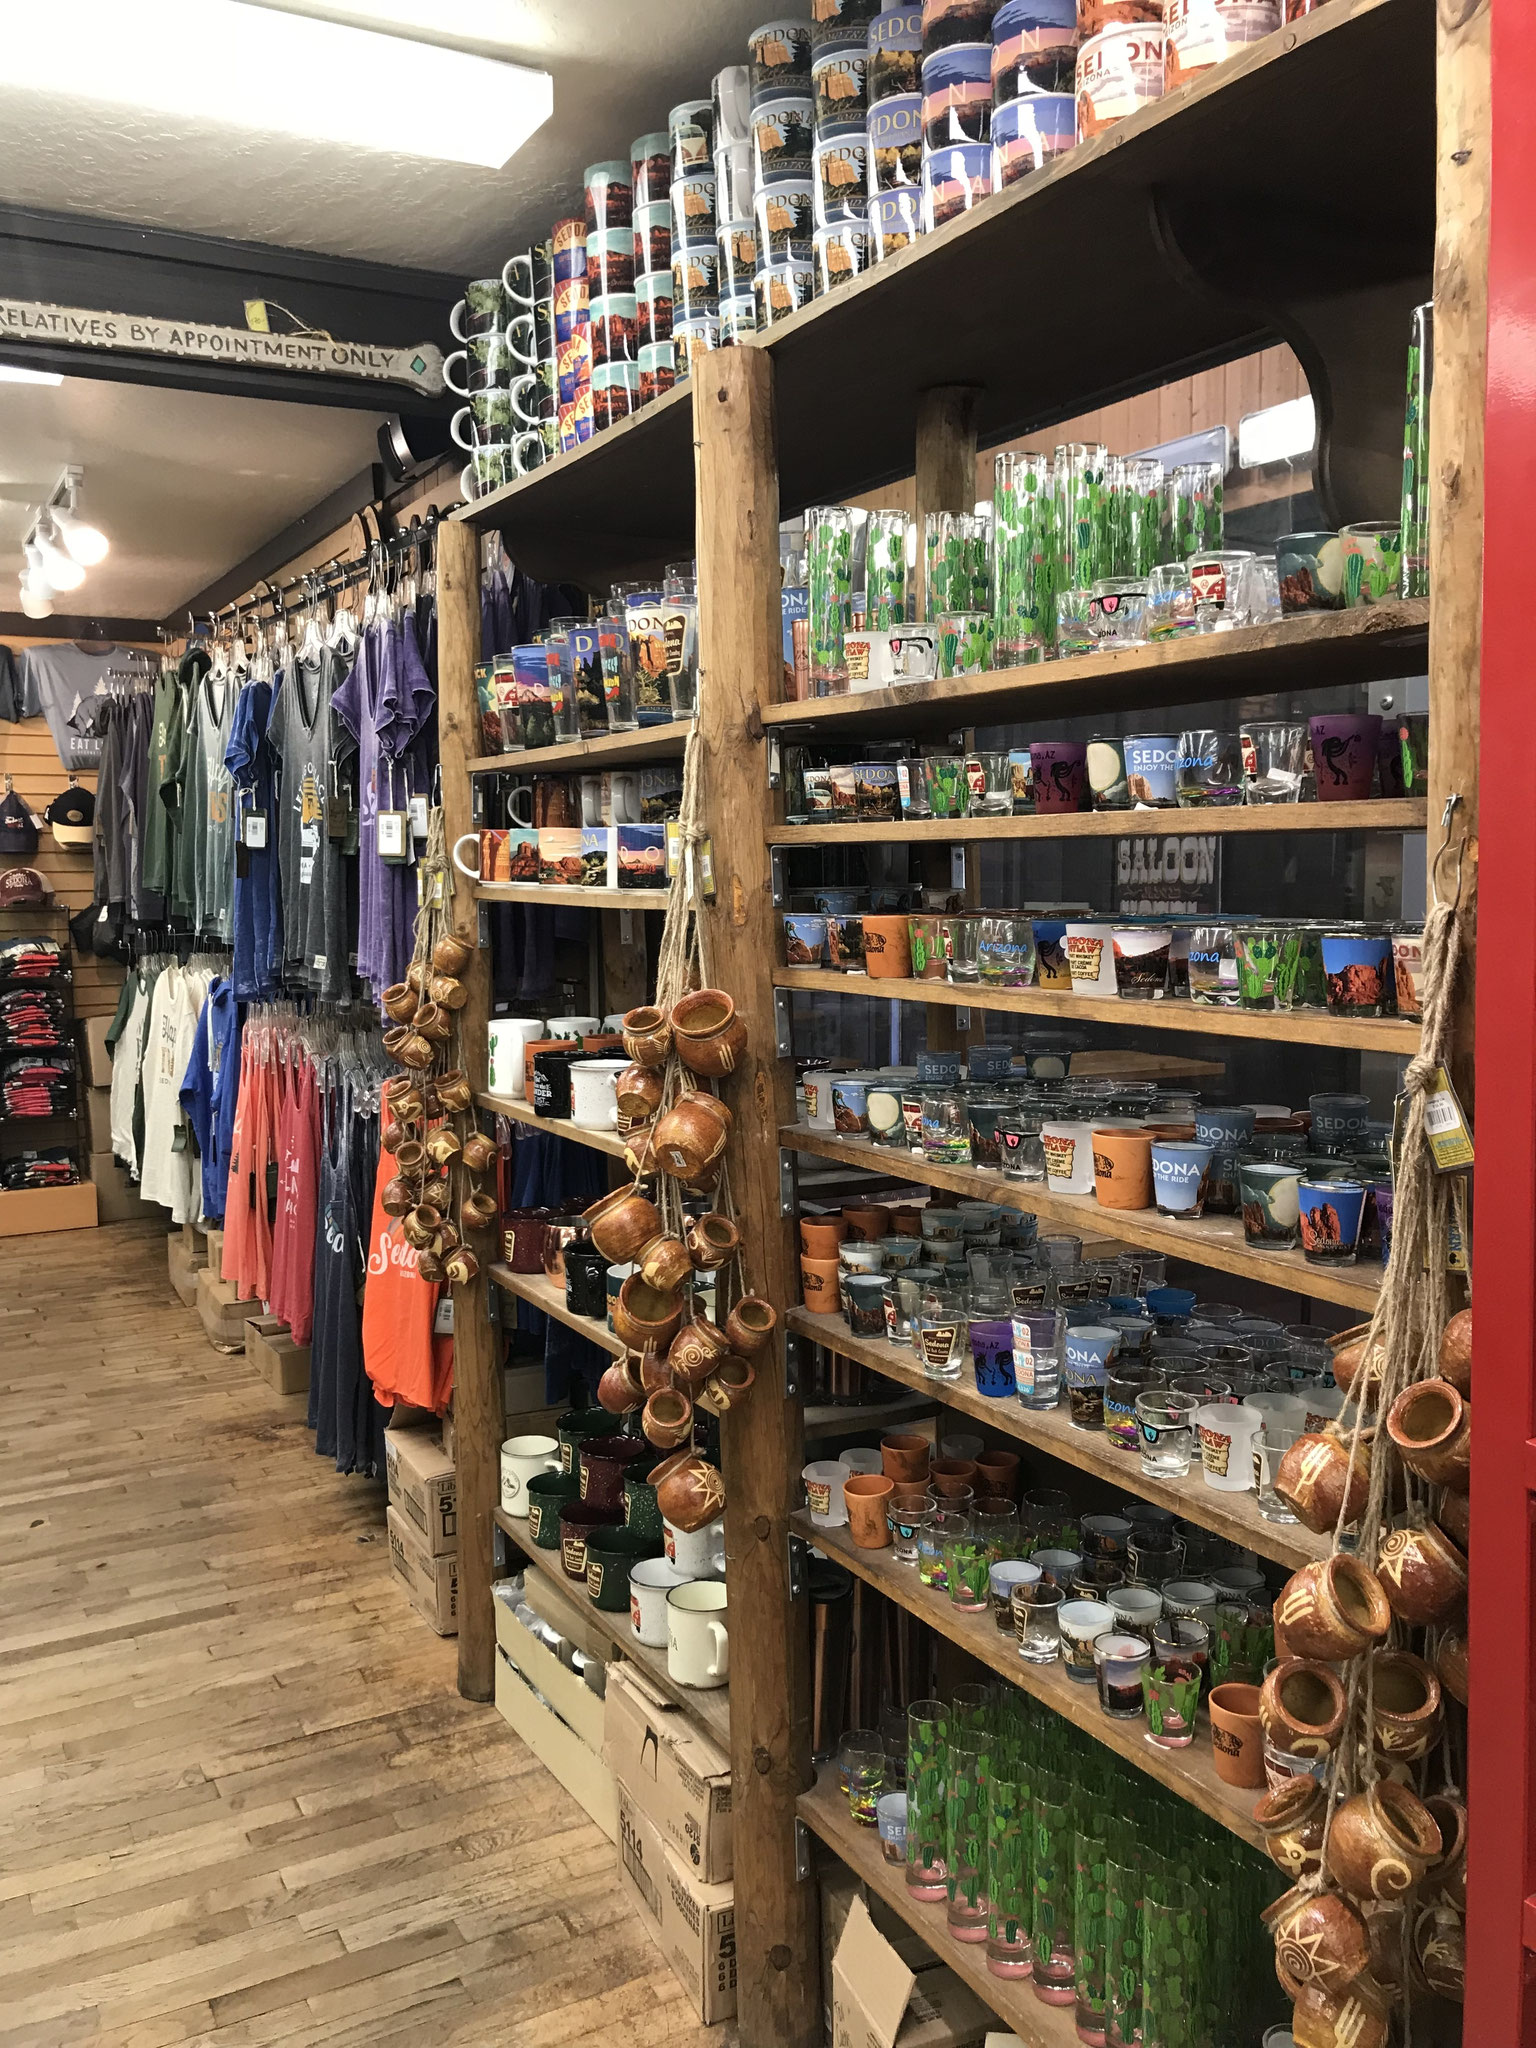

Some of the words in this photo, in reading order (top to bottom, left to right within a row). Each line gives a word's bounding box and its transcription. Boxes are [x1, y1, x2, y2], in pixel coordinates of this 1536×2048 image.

[820, 59, 868, 80] SEDO
[820, 145, 866, 164] SEDO
[130, 324, 160, 343] BY
[169, 329, 326, 361] APPOINTMENT
[331, 347, 394, 368] ONLY
[70, 737, 89, 750] EAT
[1134, 764, 1158, 772] ENJOY
[1117, 836, 1216, 885] SALOON
[979, 940, 1027, 953] Arizona
[1171, 1176, 1189, 1184] RIDE
[924, 1338, 950, 1348] Sedona
